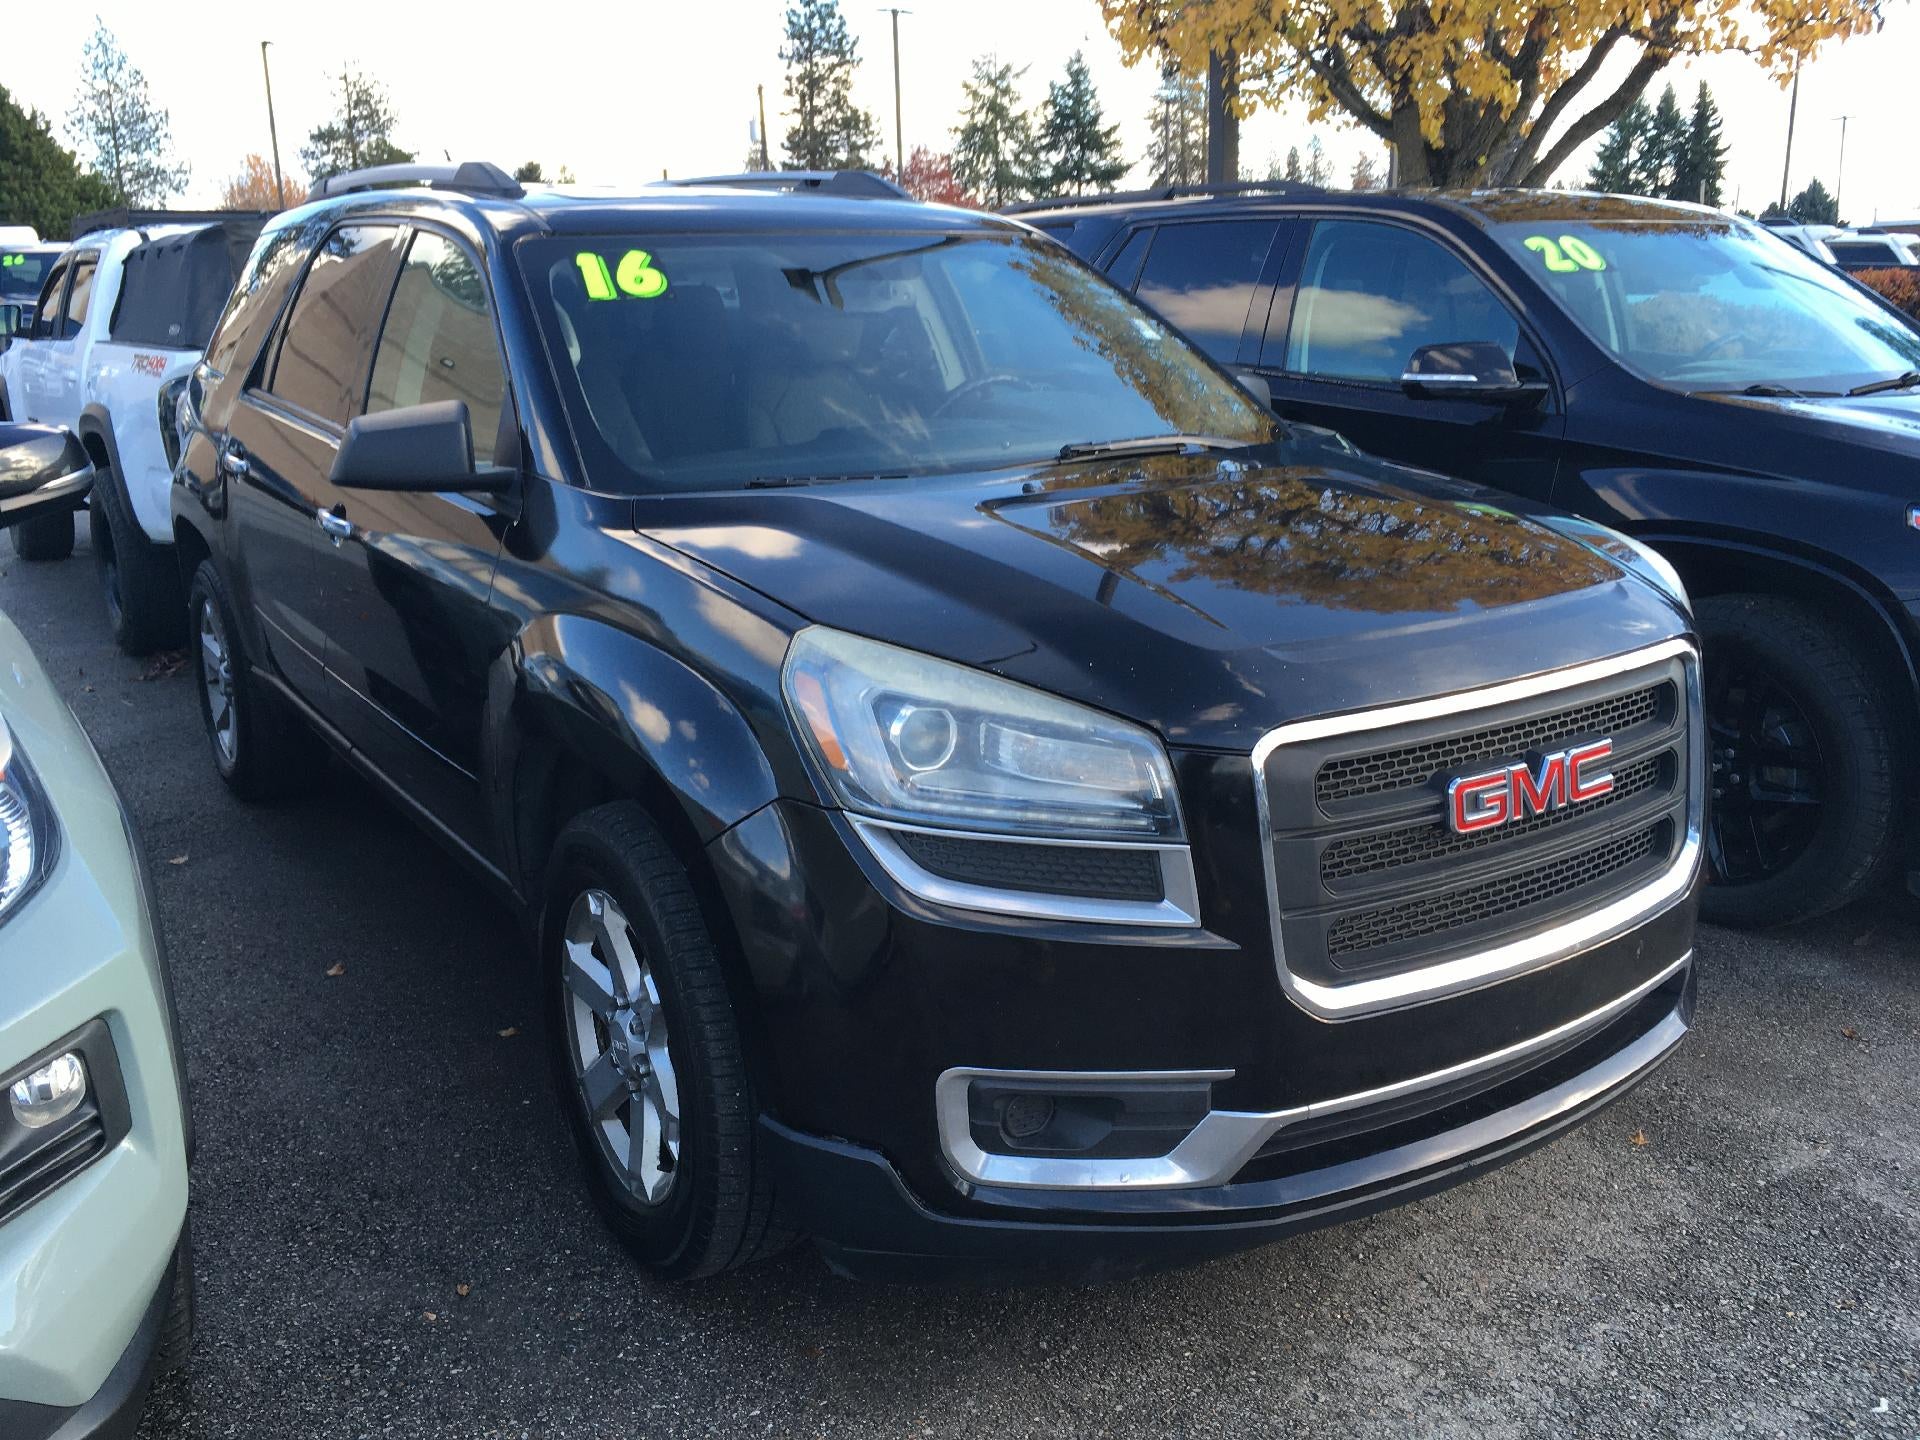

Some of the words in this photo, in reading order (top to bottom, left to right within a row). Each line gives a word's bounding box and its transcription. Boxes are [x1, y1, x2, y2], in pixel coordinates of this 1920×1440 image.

[576, 249, 668, 301] 16
[1523, 235, 1607, 273] 20
[1448, 738, 1614, 833] GMC
